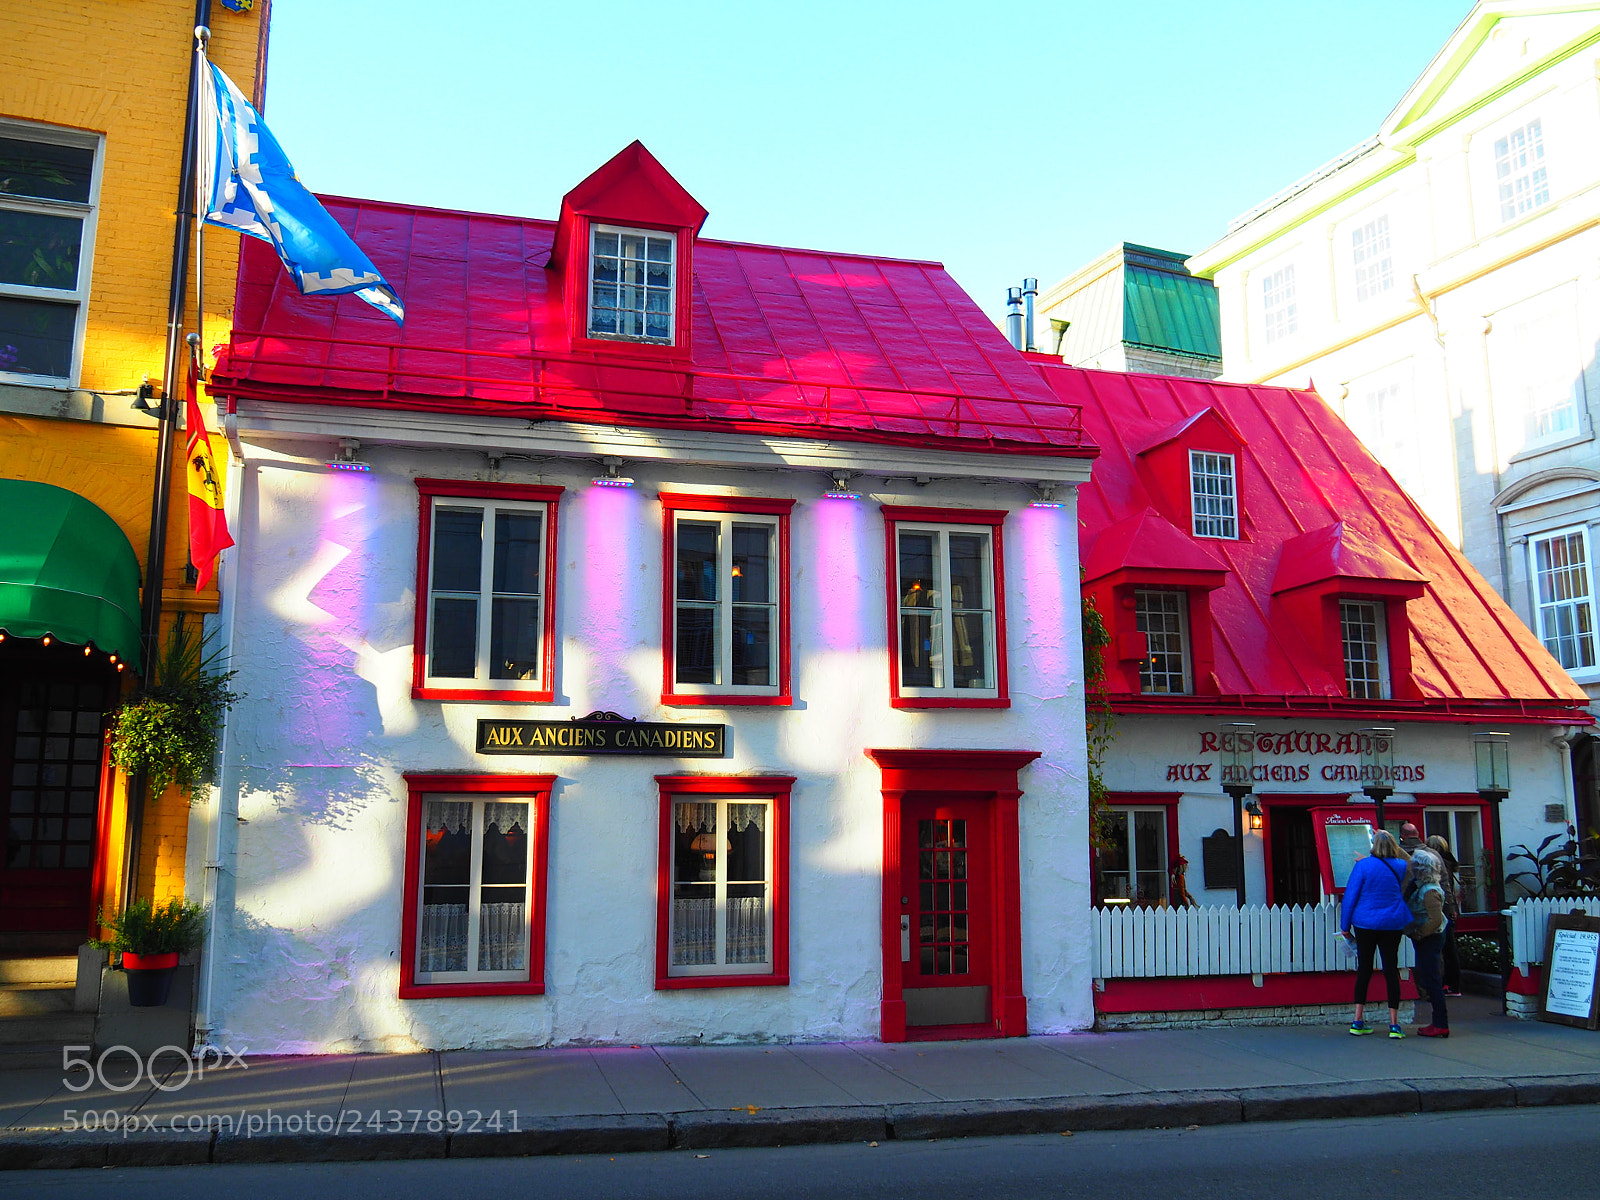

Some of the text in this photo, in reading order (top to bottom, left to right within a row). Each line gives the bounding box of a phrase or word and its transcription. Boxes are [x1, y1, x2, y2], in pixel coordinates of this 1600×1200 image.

[486, 726, 715, 749] AUX ANCIENS CANADIENS
[1199, 731, 1390, 755] RESTAURANT
[1166, 763, 1426, 783] AUX ANCIENS CANADIENS
